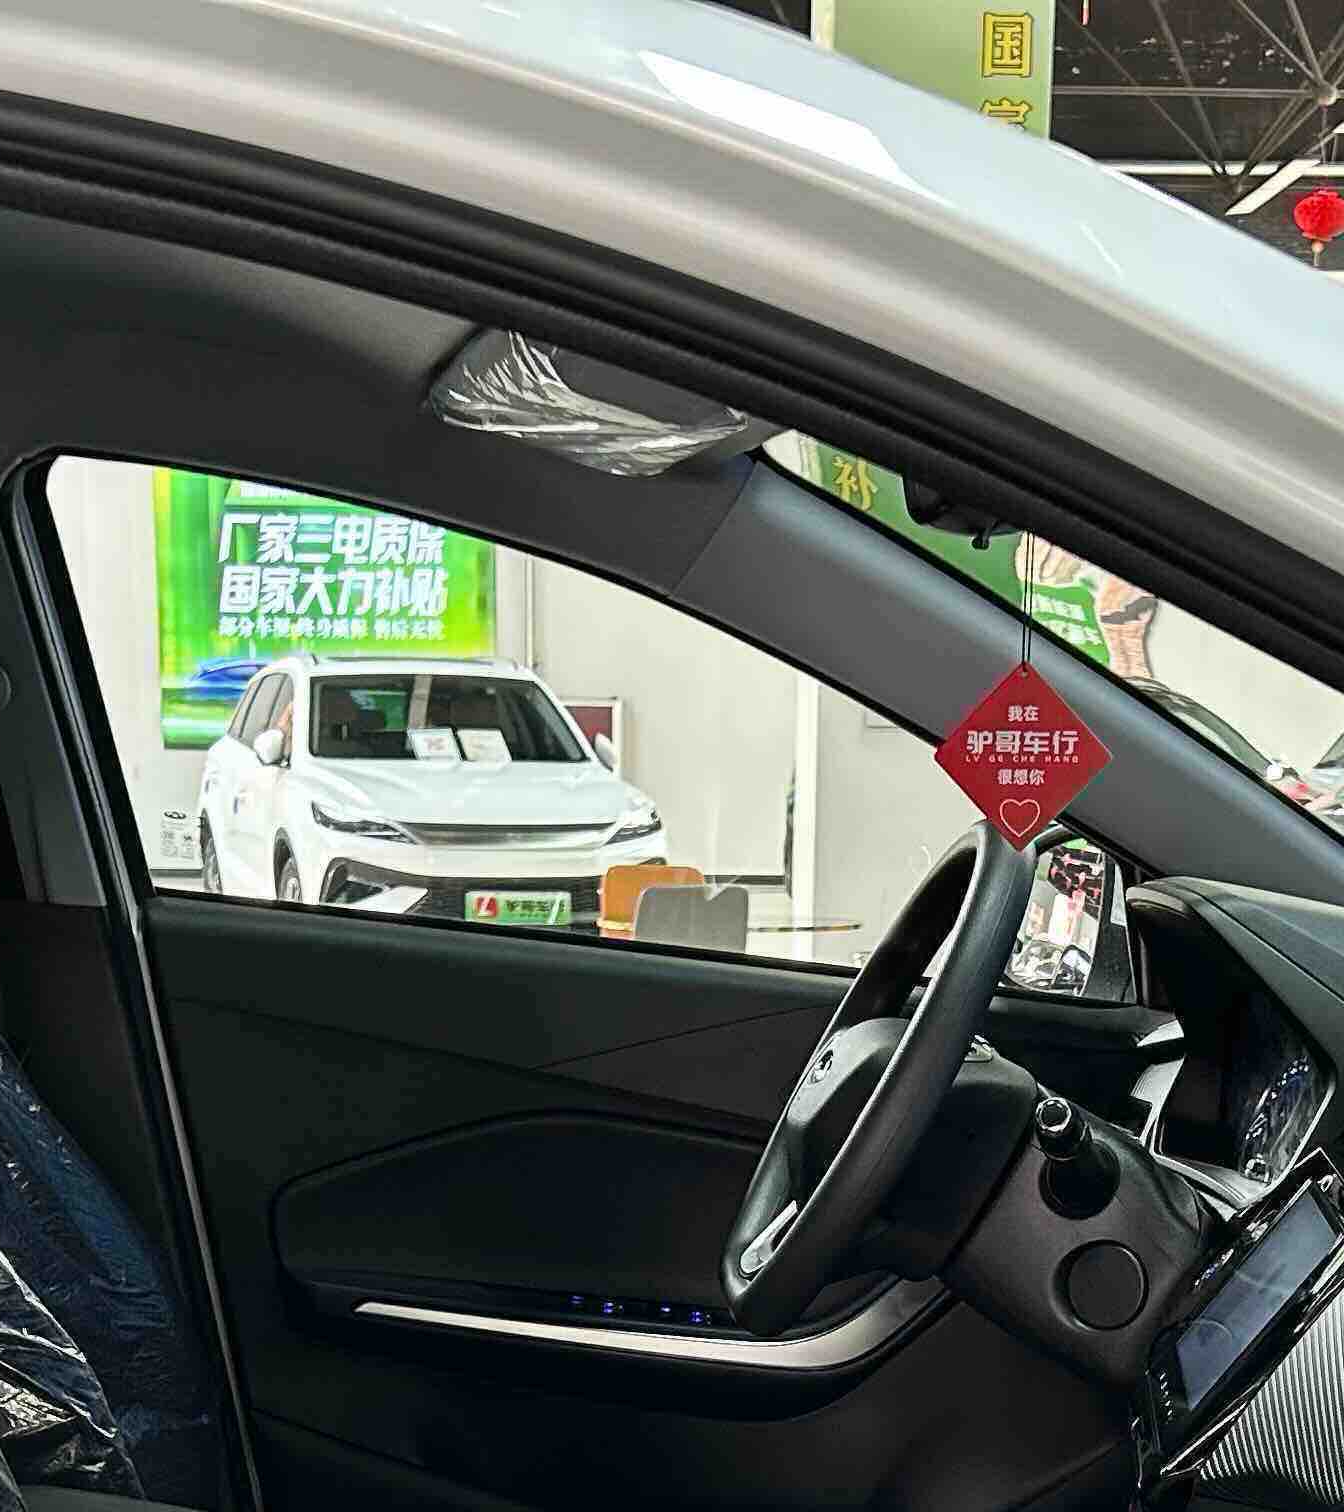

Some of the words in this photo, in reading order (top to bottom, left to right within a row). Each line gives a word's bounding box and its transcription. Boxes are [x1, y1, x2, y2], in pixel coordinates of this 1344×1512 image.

[218, 512, 446, 565] 厂家三电质保
[219, 564, 449, 617] 国家大力补贴
[1007, 704, 1041, 722] 我在
[966, 730, 1080, 755] 驴哥车行
[997, 768, 1046, 787] 很想你
